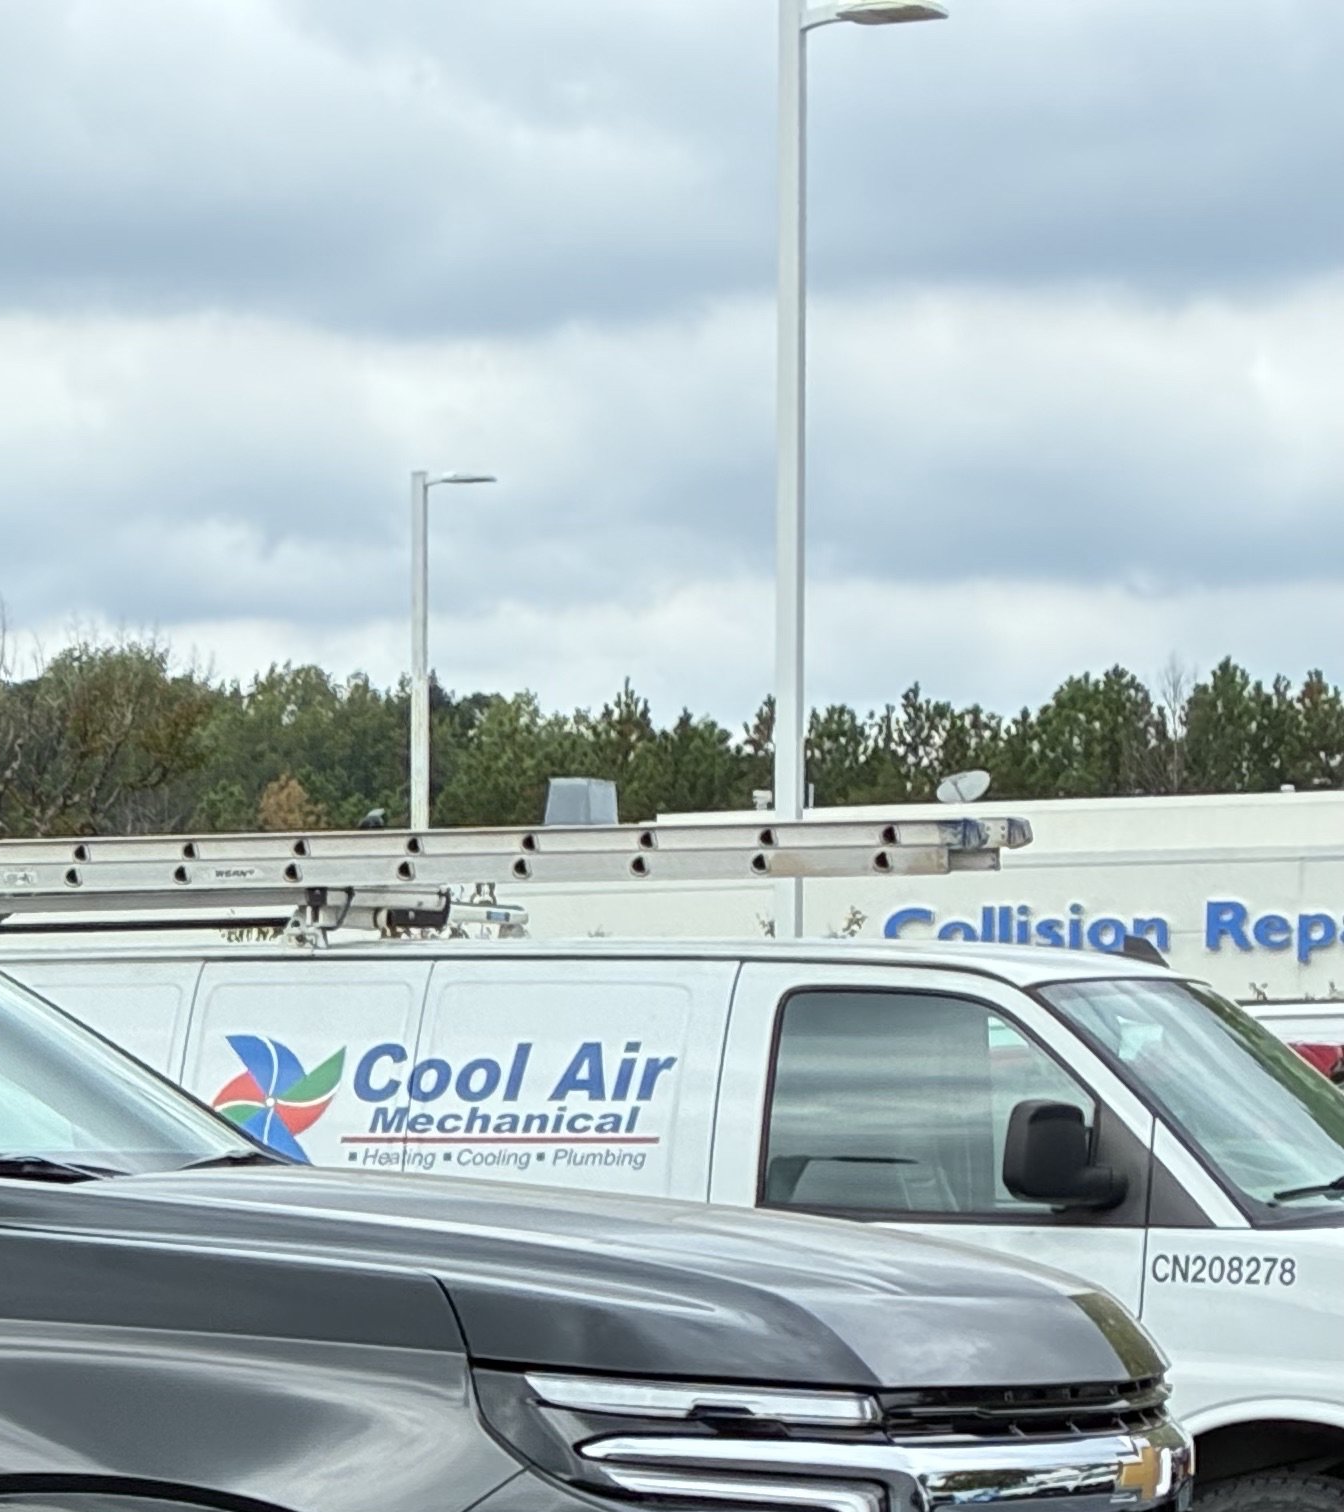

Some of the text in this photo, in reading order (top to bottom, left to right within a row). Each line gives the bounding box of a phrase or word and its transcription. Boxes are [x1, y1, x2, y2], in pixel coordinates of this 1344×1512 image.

[1206, 901, 1344, 965] Rep
[353, 1041, 677, 1102] Cool Air
[368, 1106, 640, 1134] Mechanical
[456, 1148, 531, 1170] Cooling
[552, 1148, 647, 1170] Plumbing
[1152, 1254, 1296, 1285] CN208278
